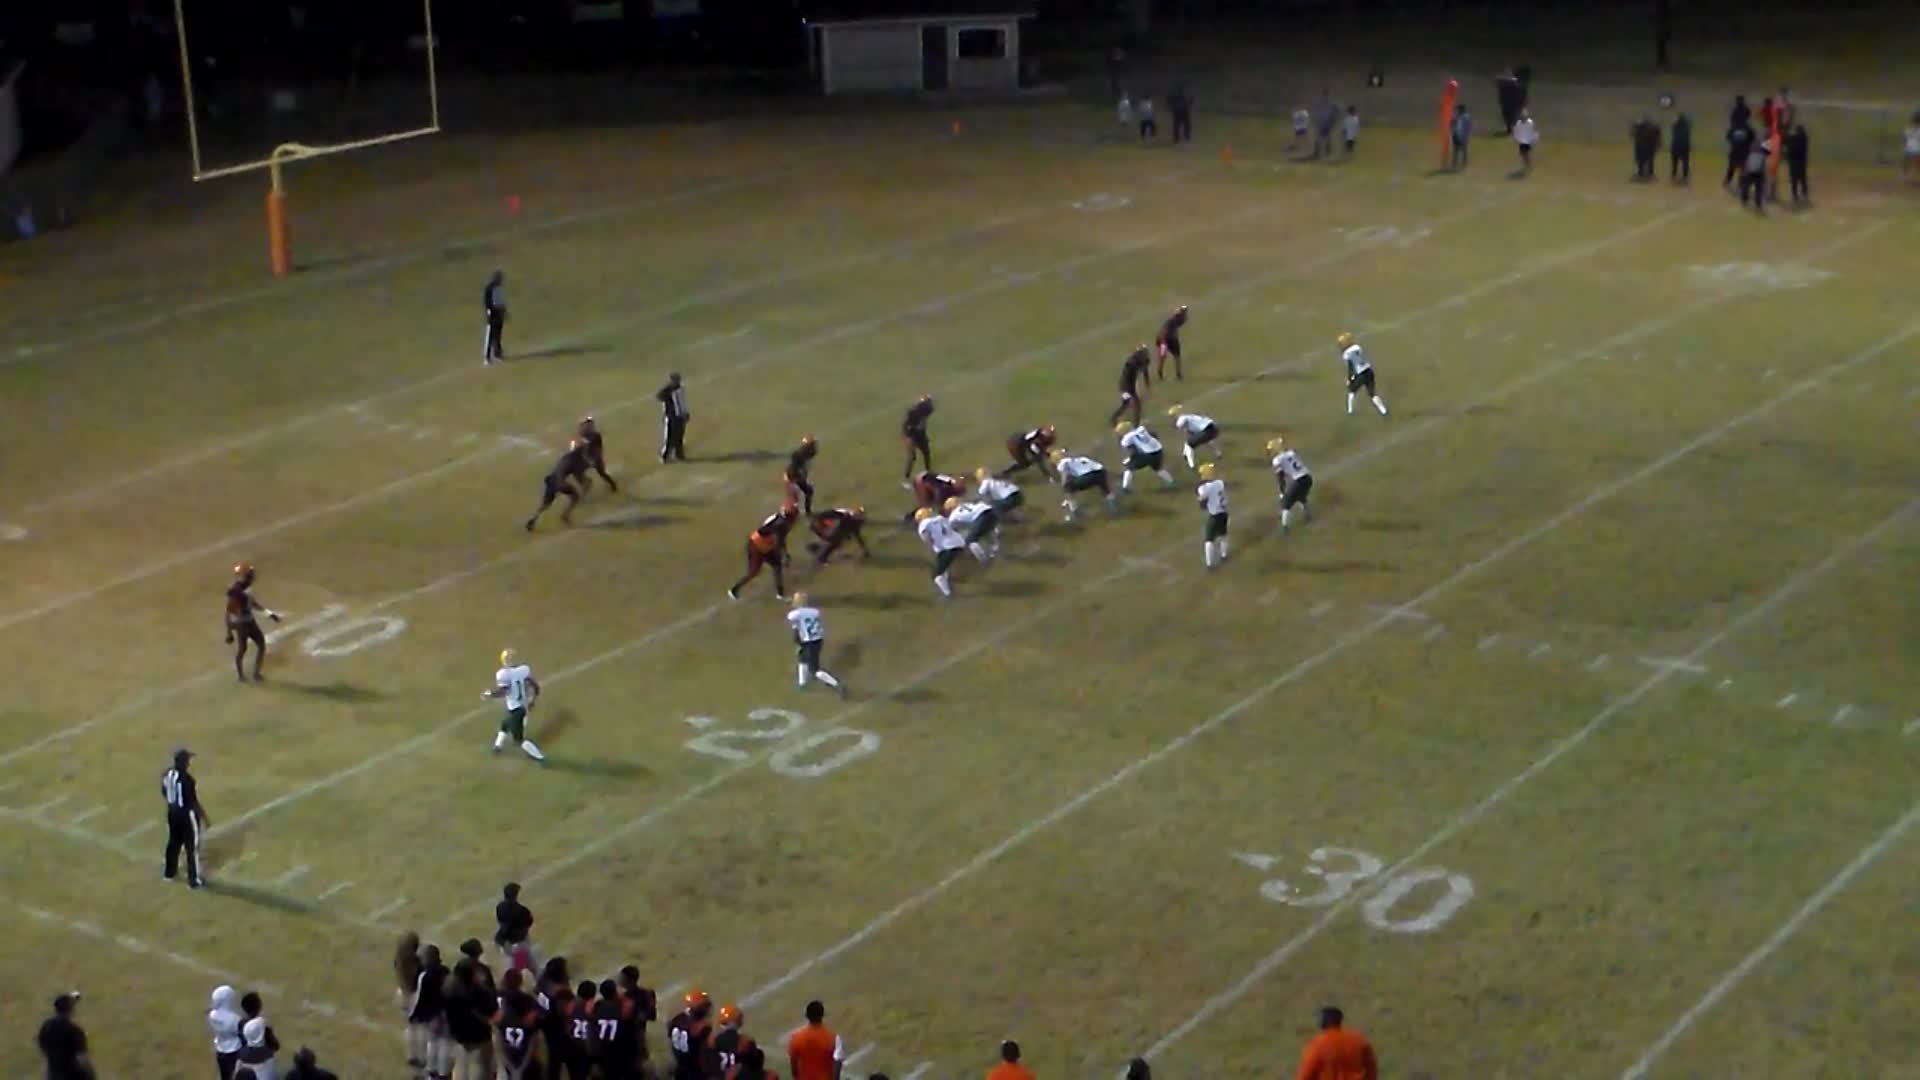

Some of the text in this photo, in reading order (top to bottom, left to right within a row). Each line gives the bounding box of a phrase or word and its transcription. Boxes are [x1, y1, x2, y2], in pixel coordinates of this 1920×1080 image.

[684, 708, 880, 777] 20
[1260, 848, 1474, 932] 30
[598, 1019, 618, 1041] 77
